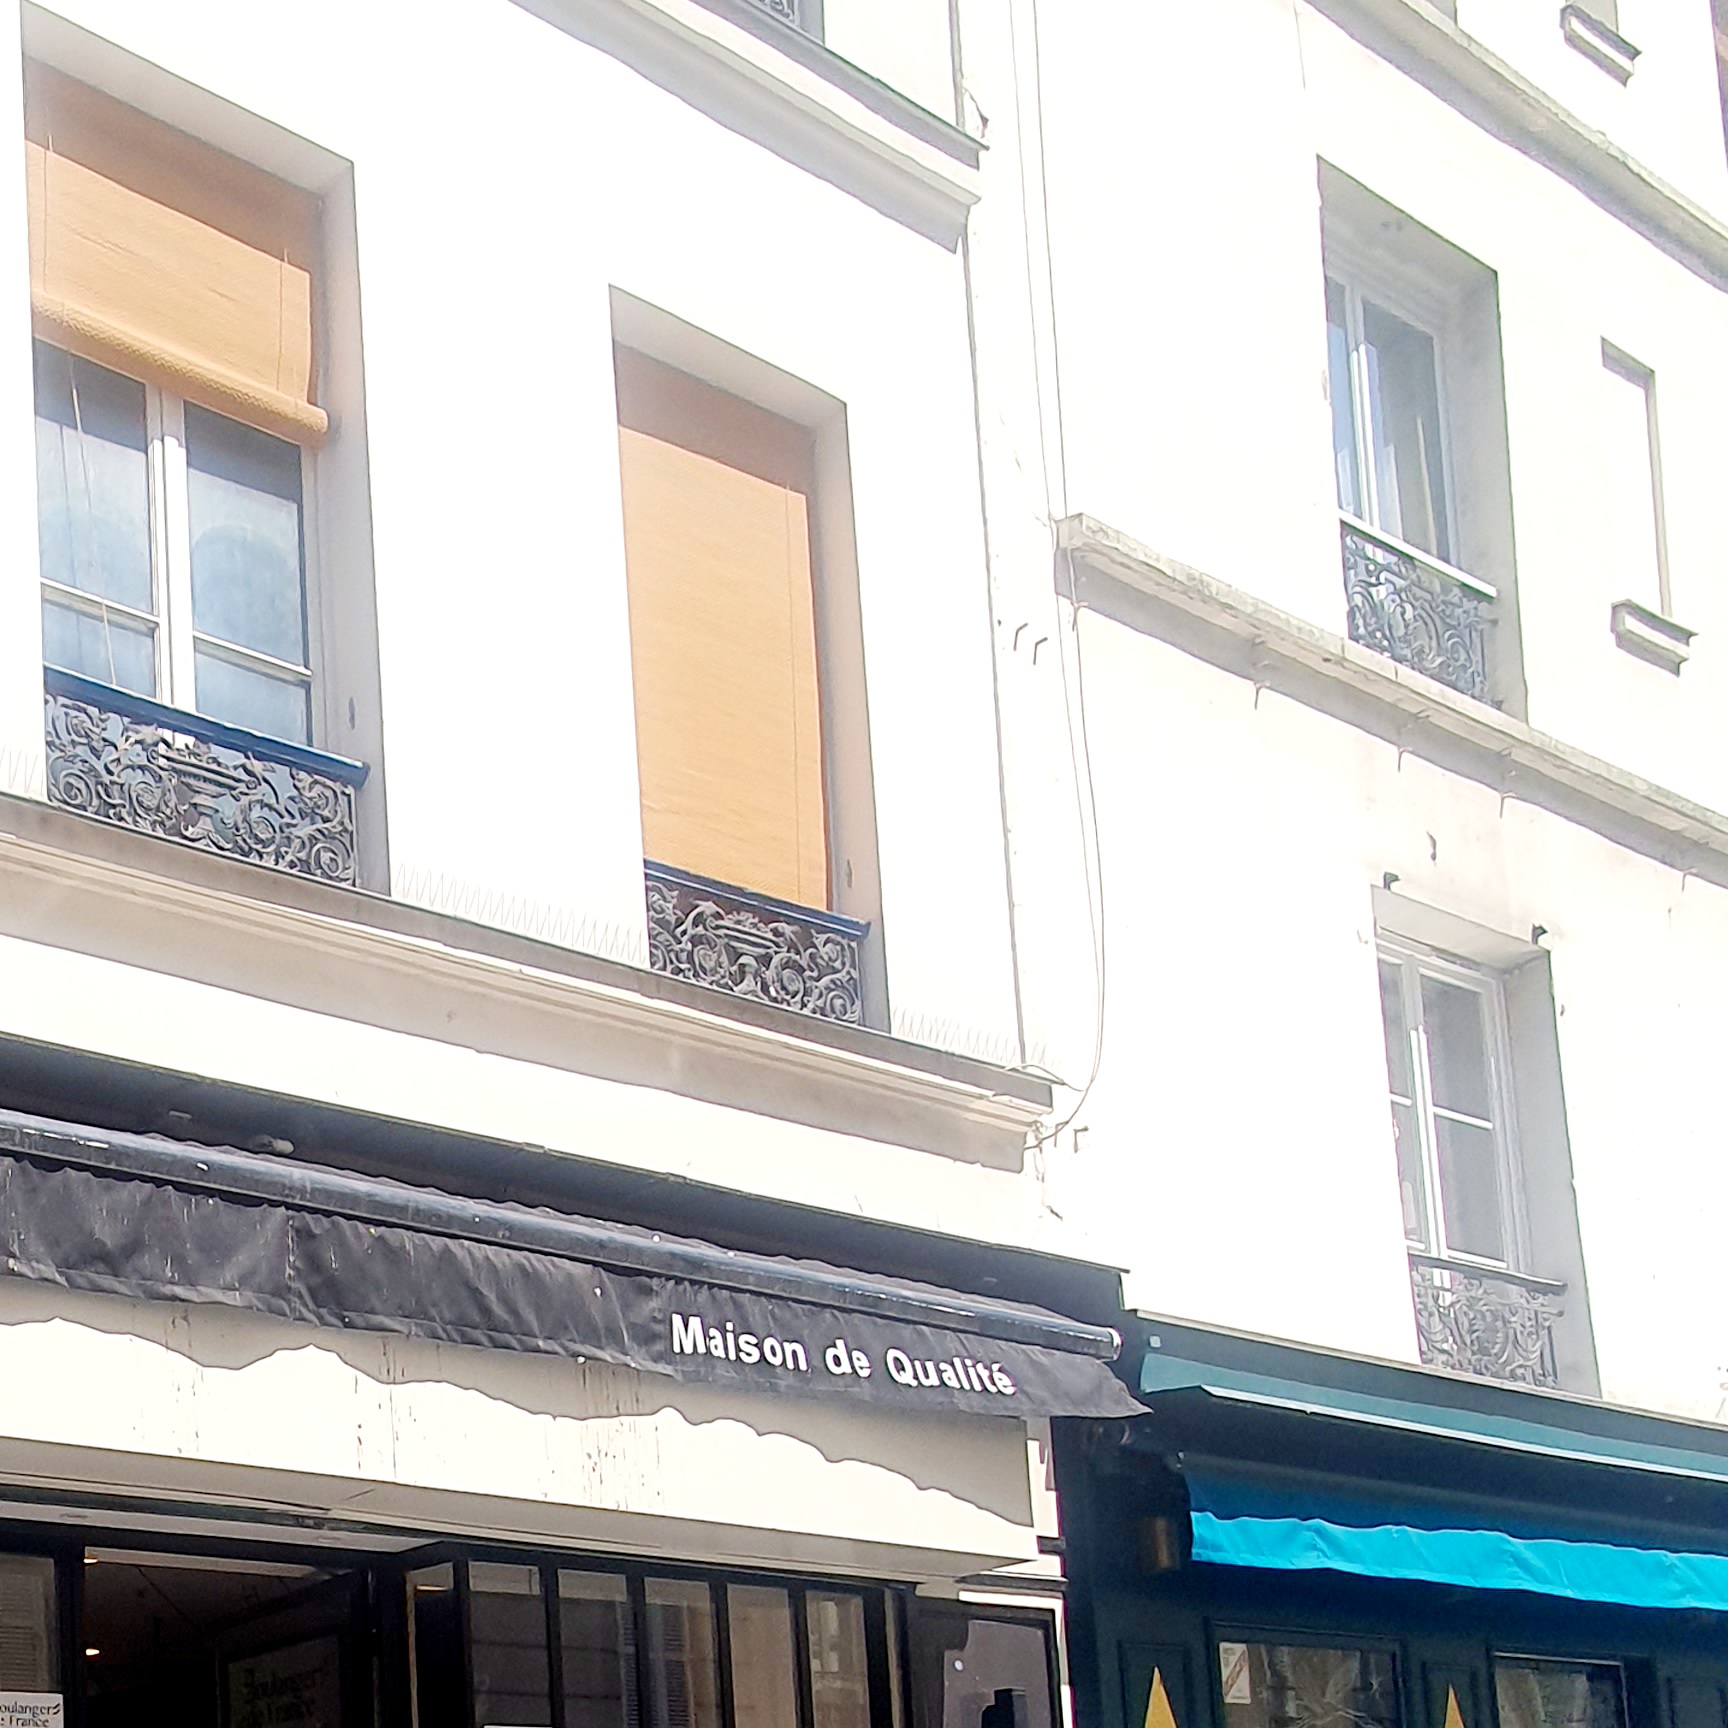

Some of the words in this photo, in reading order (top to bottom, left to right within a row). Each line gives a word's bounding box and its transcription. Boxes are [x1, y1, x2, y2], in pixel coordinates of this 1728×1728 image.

[671, 1312, 808, 1373] Maison
[825, 1339, 872, 1378] de
[886, 1347, 1017, 1396] Qualité
